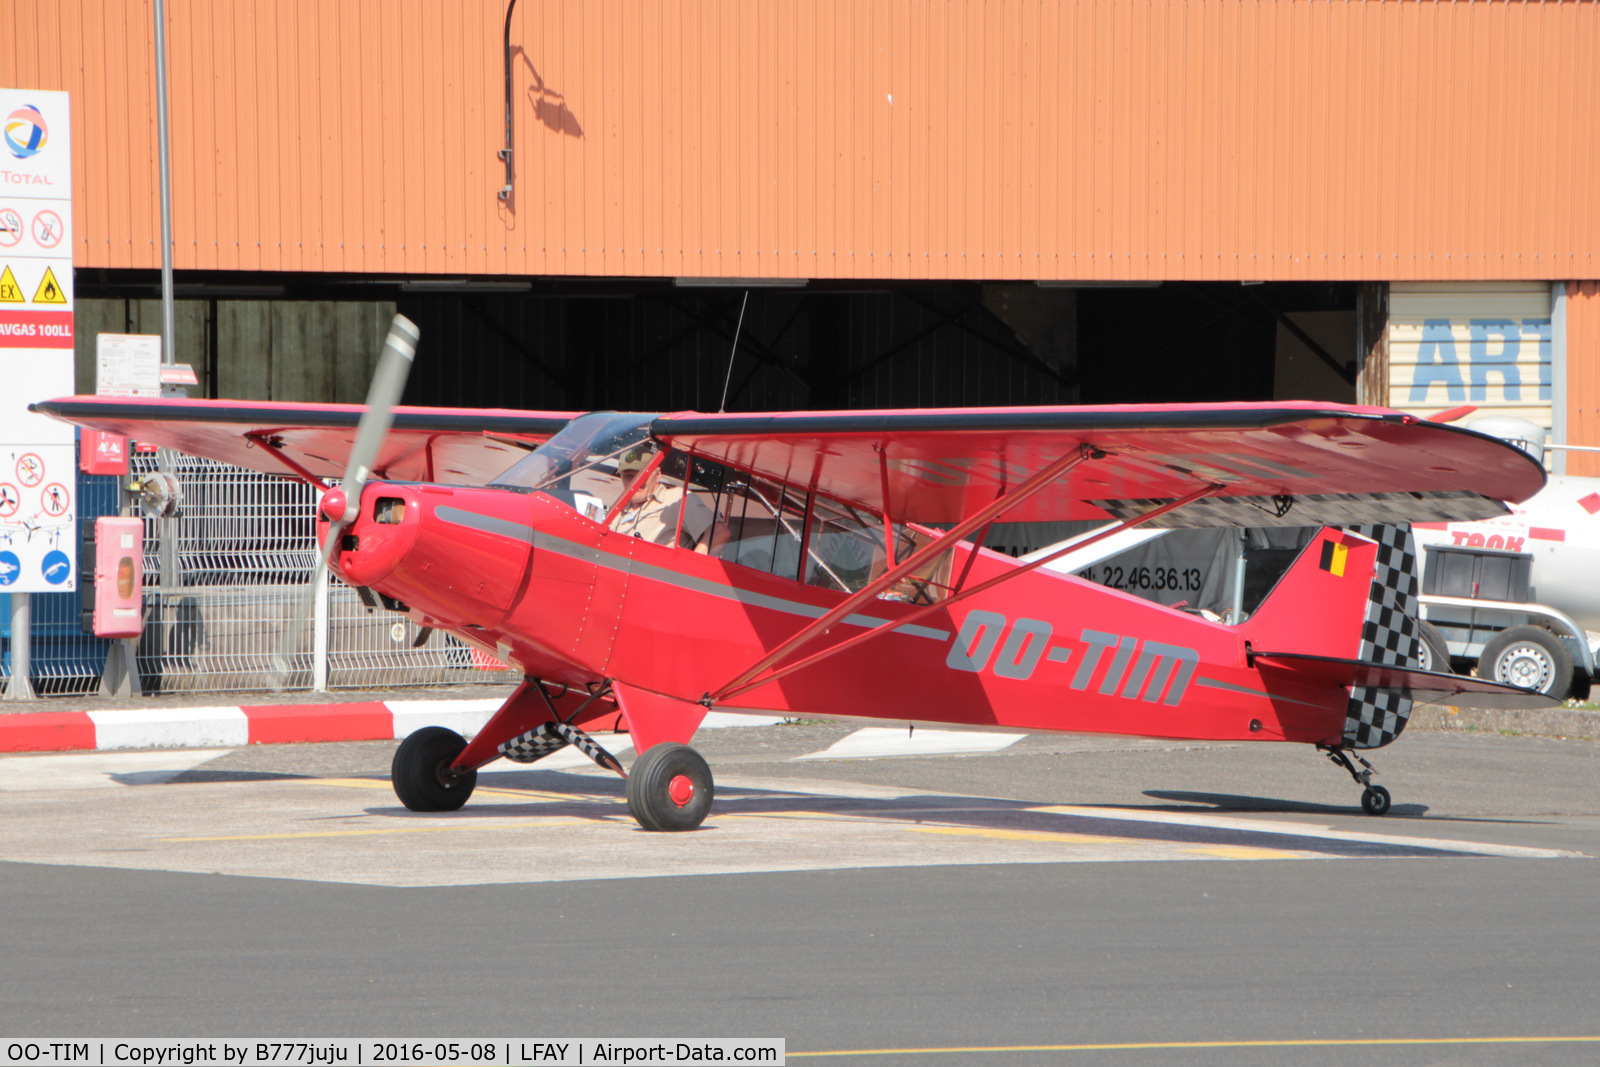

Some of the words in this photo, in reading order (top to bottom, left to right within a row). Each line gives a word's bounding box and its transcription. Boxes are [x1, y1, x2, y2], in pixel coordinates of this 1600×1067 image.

[1, 170, 54, 185] TOTAL
[1, 284, 15, 299] EX
[0, 323, 37, 336] AVGAS
[38, 324, 72, 337] 100LL
[10, 452, 15, 460] 1
[67, 513, 73, 522] 3
[67, 580, 73, 589] 5
[1103, 566, 1201, 591] 22.46.36.13
[946, 609, 1199, 707] OO-TIM
